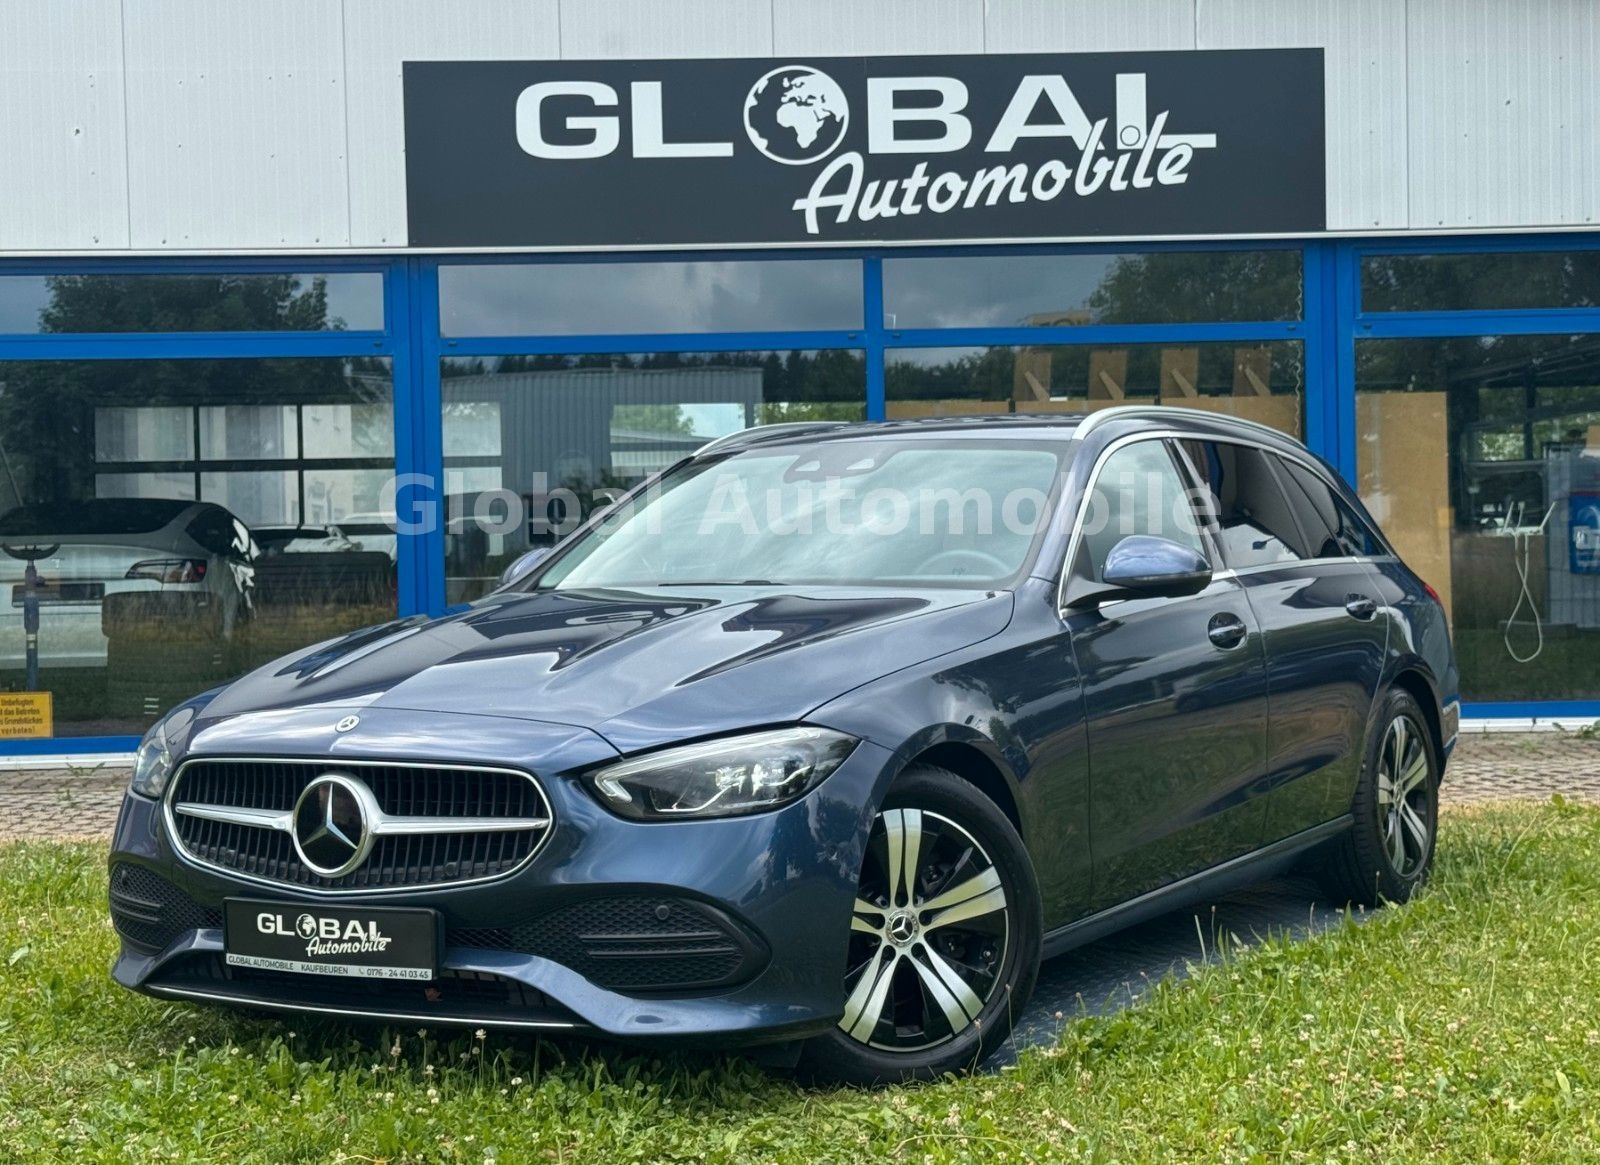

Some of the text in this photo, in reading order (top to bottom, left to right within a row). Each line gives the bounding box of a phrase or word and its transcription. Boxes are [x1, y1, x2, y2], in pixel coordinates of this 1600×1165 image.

[792, 110, 1193, 234] Automobile
[306, 931, 387, 957] Automobile
[229, 955, 252, 965] GLOBAL
[253, 959, 294, 971] AUTOMOBILE
[301, 963, 348, 974] KAUFBEUREN
[366, 968, 383, 977] 0176
[388, 969, 398, 977] 24
[399, 970, 407, 978] 41
[408, 970, 418, 978] 03
[419, 971, 429, 979] 45
